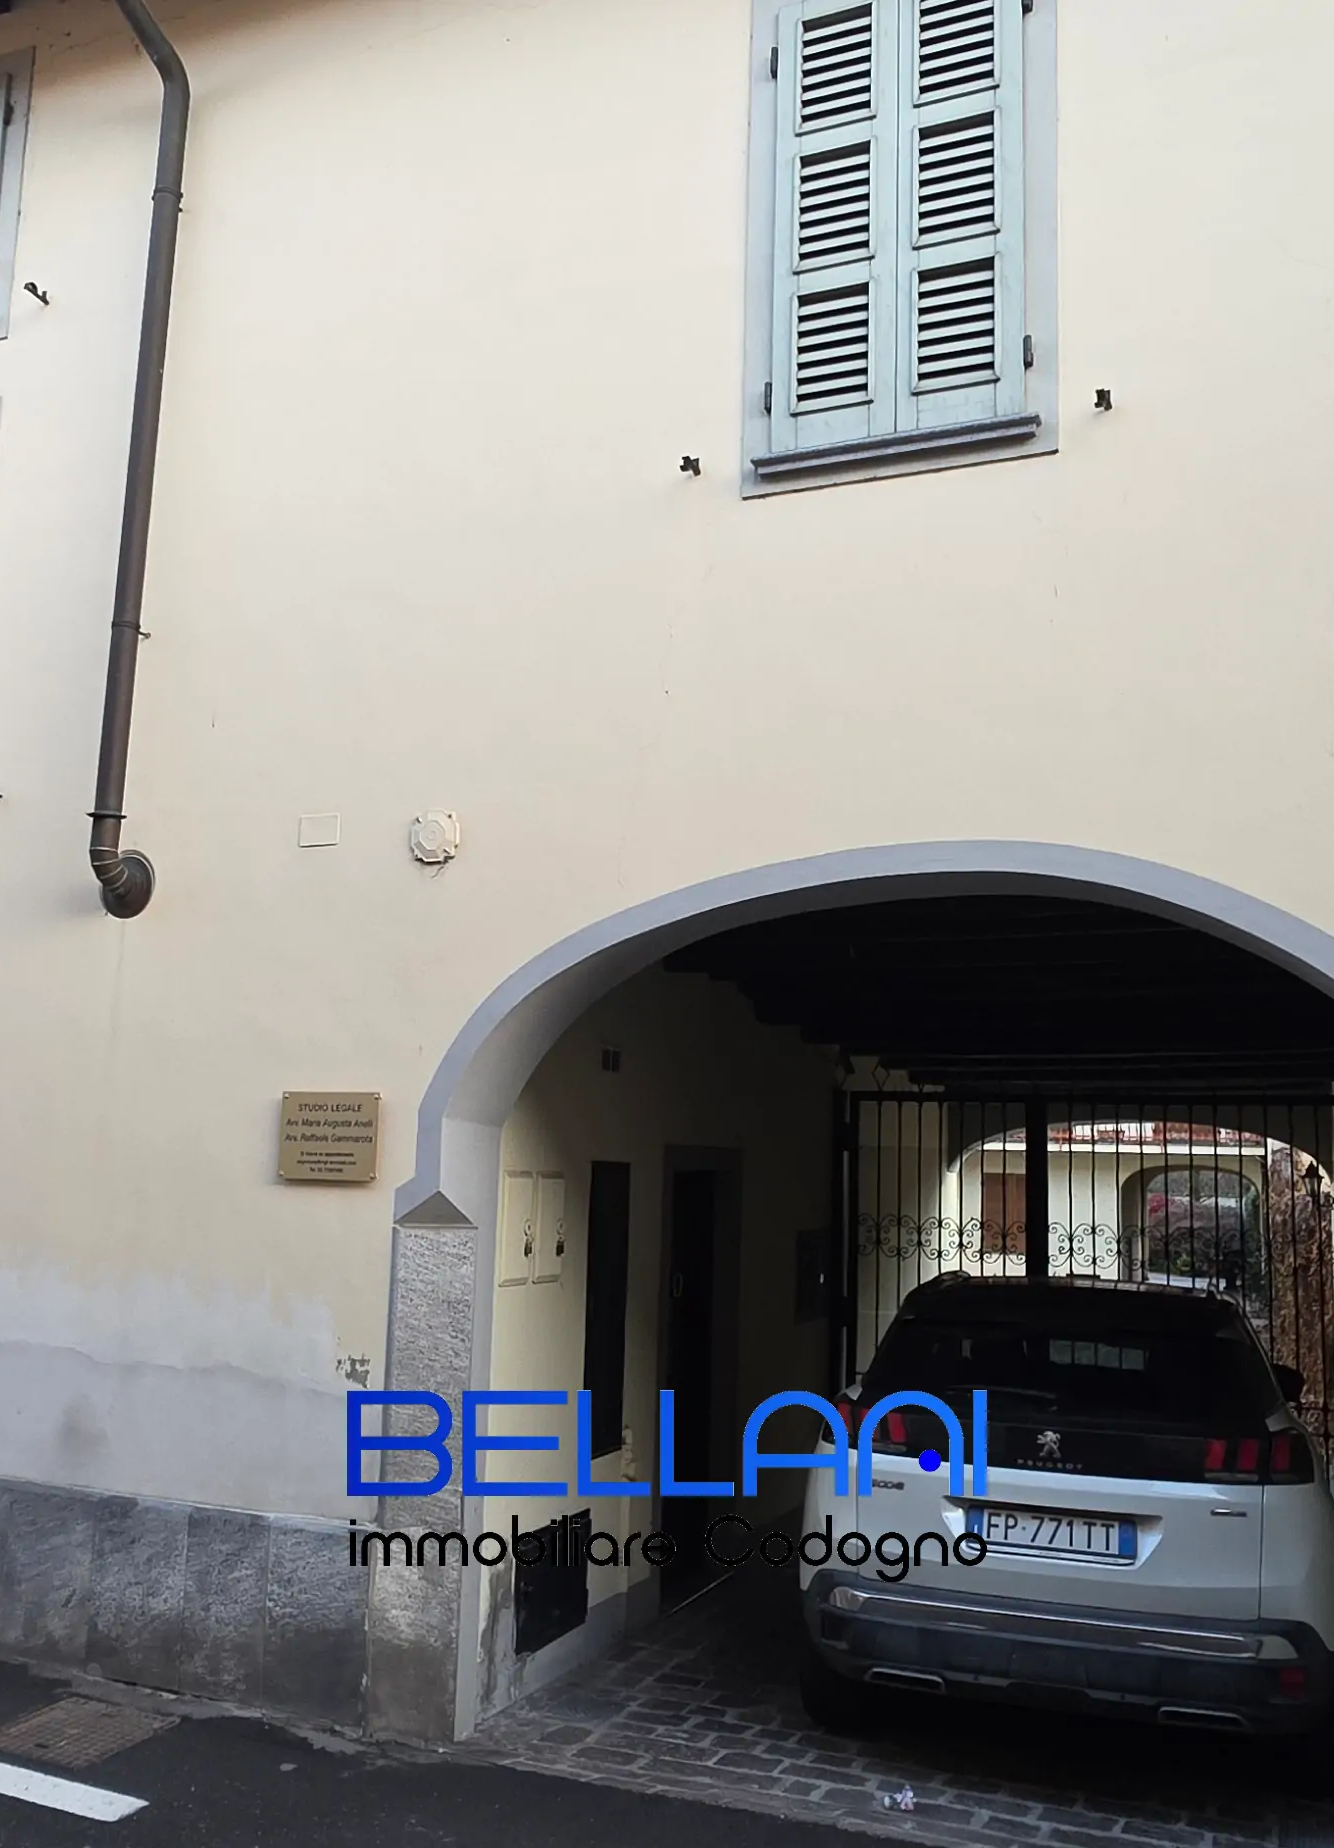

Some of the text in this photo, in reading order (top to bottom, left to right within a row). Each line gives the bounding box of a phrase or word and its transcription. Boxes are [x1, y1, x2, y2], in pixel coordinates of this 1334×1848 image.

[298, 1104, 362, 1112] STUDIO LEGALE
[300, 1118, 322, 1127] Maria
[322, 1119, 352, 1129] Augusta
[1016, 1458, 1083, 1471] PEUGEOT
